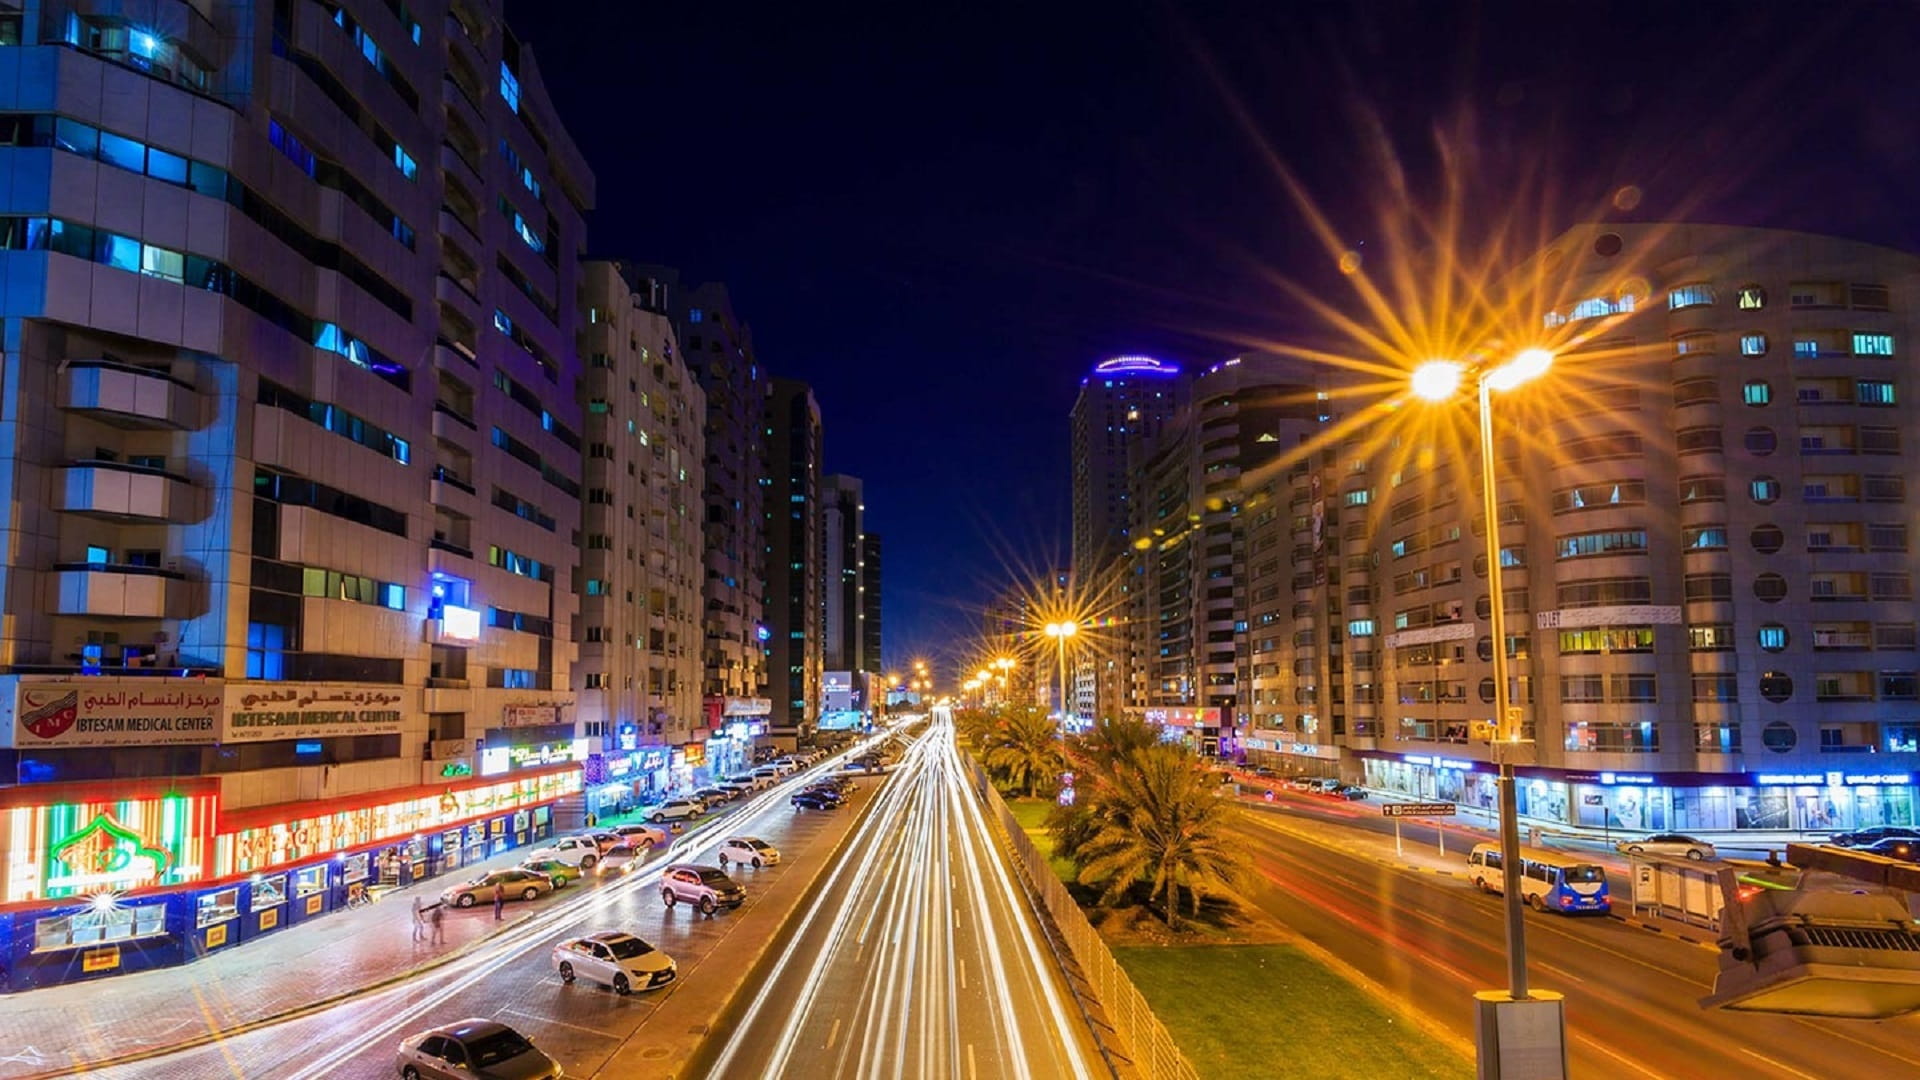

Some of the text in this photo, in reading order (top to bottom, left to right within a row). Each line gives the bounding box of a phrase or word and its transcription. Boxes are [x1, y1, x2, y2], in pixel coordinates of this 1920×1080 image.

[1548, 611, 1561, 626] LET
[84, 691, 221, 714] مركز ابتسام الطبي
[76, 716, 214, 732] IBTESAM MEDICAL CENTER
[231, 709, 401, 727] IBTESAM MEDICAL CENTER
